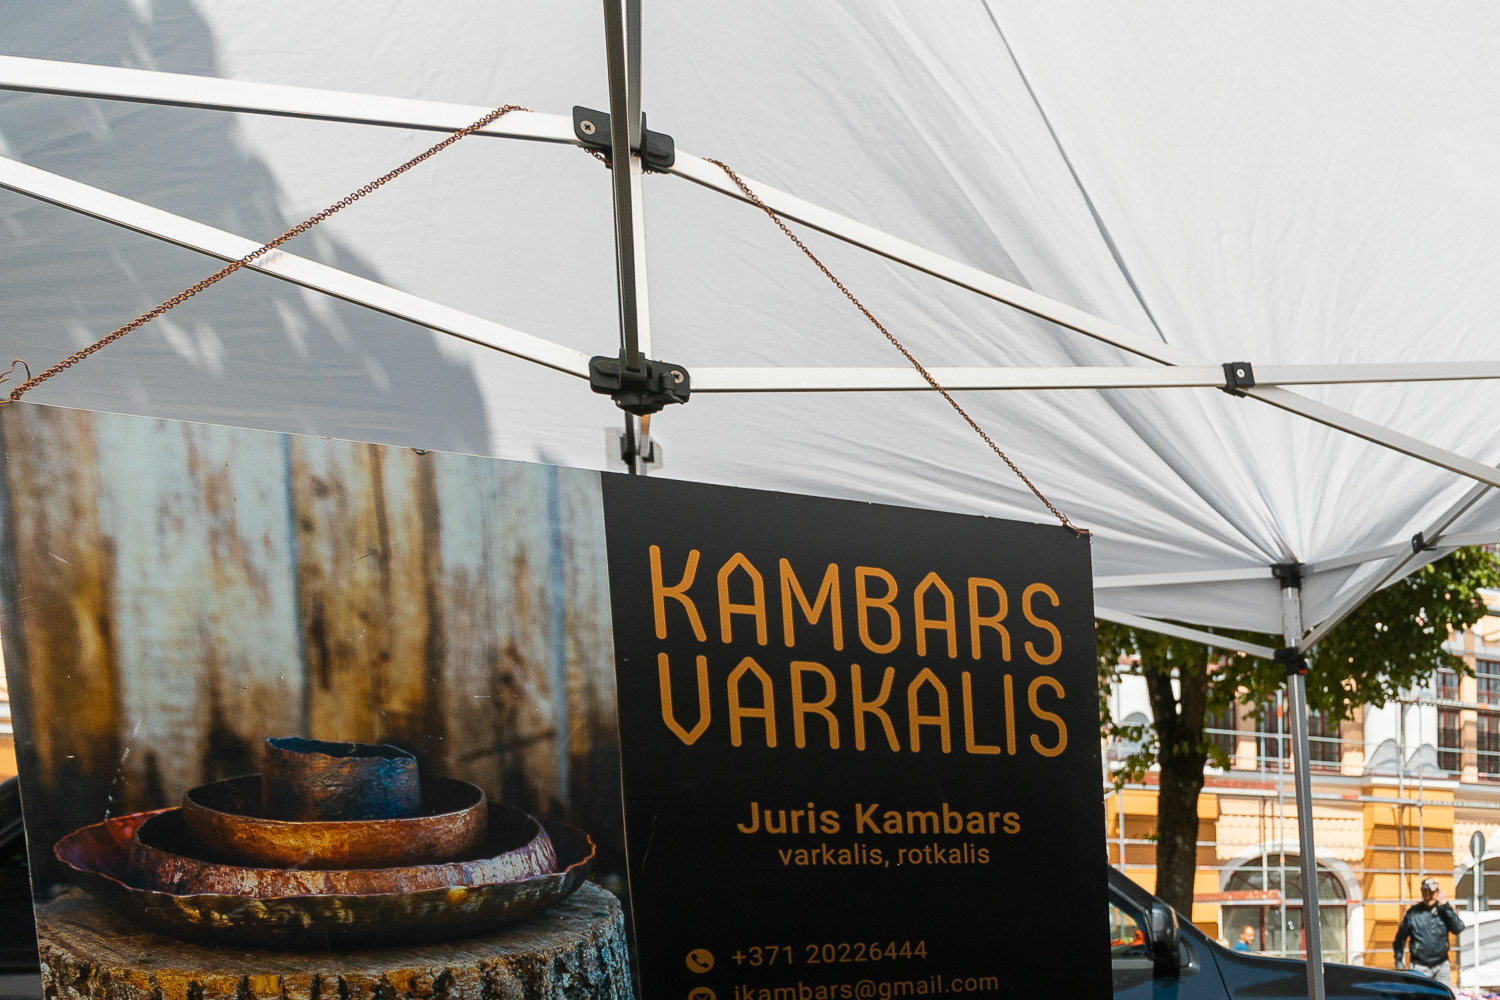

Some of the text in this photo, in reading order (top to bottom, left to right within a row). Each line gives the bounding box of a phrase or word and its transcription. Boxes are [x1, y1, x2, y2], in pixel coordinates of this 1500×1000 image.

[648, 543, 1063, 667] KAMBARS
[656, 651, 1069, 758] VARKALIS
[736, 801, 1021, 835] Juris Kambars
[777, 842, 991, 868] varkalis, rotkalis
[731, 940, 928, 967] +371 20226444
